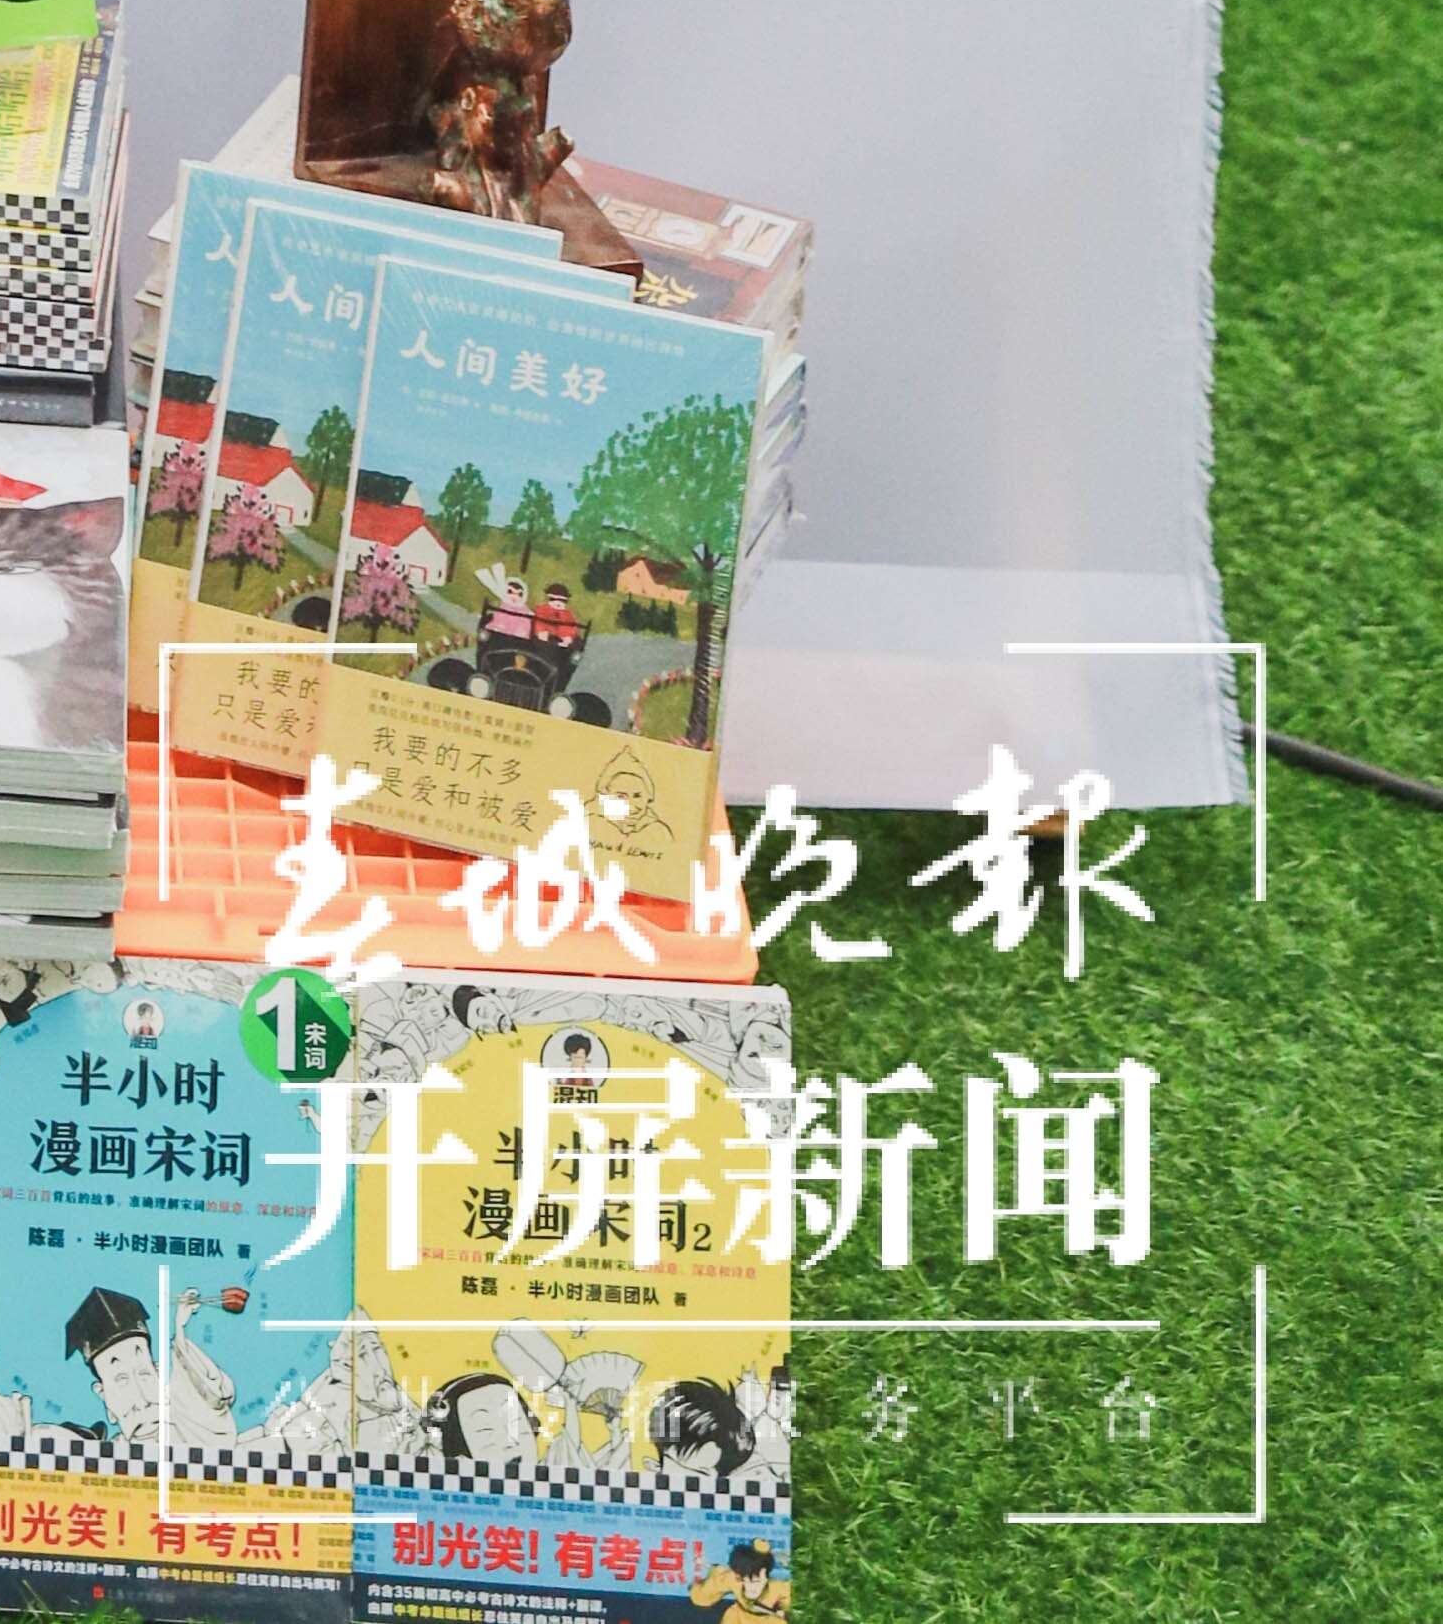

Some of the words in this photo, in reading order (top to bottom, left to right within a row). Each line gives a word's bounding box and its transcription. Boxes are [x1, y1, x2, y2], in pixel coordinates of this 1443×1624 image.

[401, 329, 608, 405] 人间美好
[371, 726, 523, 786] 我要的不多
[255, 977, 296, 1072] 1
[304, 1022, 328, 1071] 宋词
[59, 1051, 225, 1115] 半小时
[30, 1118, 252, 1186] 漫画宋词
